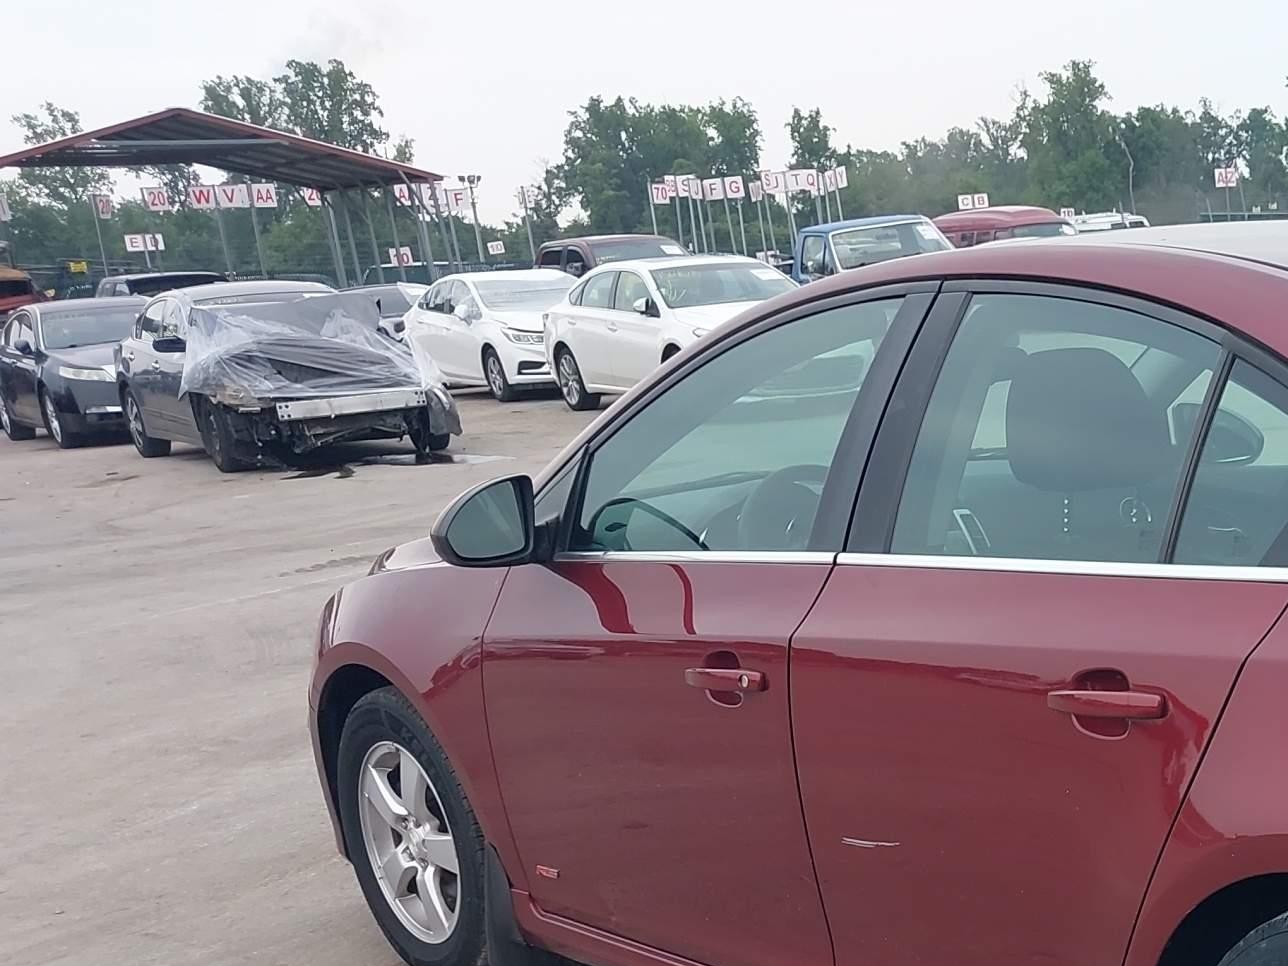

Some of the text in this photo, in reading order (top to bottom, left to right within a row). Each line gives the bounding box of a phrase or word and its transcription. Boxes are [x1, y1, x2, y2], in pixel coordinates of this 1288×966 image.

[729, 180, 740, 194] G
[791, 173, 801, 186] T
[806, 173, 816, 188] Q
[191, 188, 274, 204] W V AA
[653, 186, 668, 200] 70
[709, 183, 718, 196] F
[149, 191, 166, 206] 20
[453, 192, 463, 207] F
[961, 195, 985, 207] C B
[130, 237, 140, 249] E
